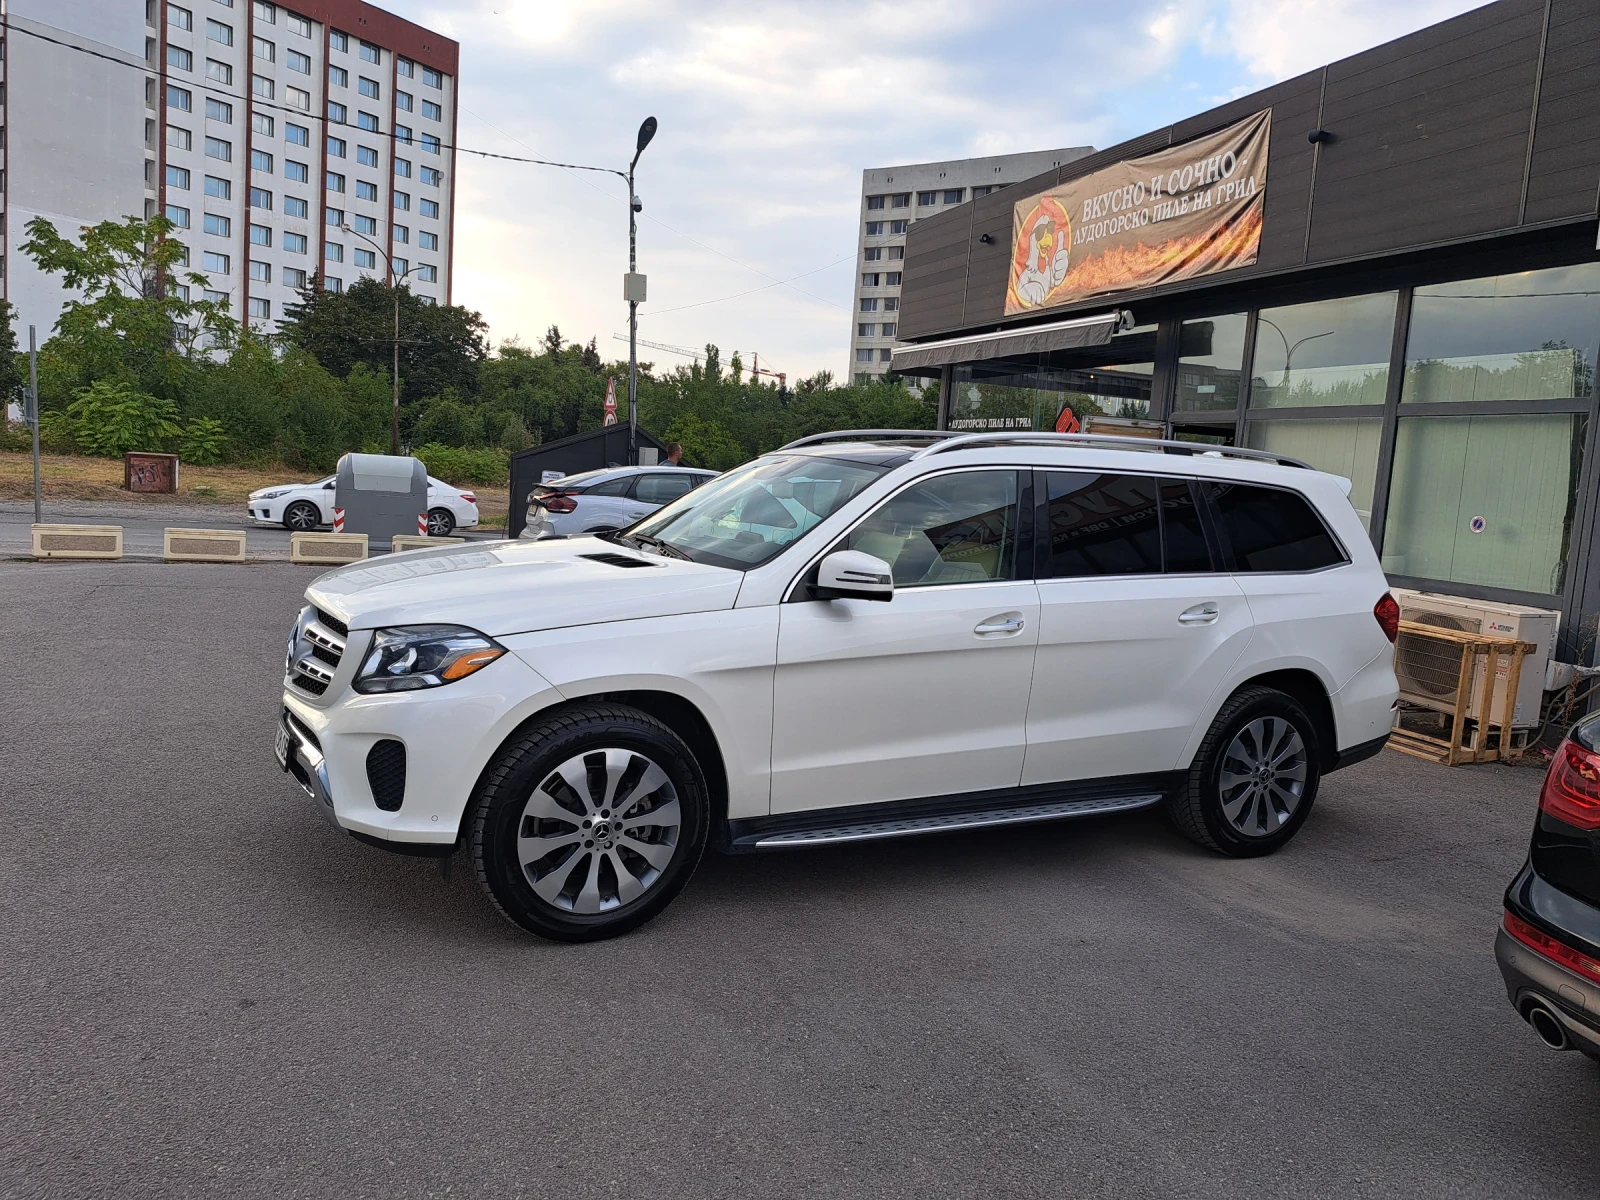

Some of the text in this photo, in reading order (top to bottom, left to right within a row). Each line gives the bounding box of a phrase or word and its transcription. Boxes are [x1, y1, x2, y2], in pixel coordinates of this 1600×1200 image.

[1073, 176, 1257, 246] ЛУДОГОРСКО ПИЛЕ НА ГРИЛ
[1082, 181, 1145, 222] ВКУСНО
[1150, 175, 1164, 202] И
[1168, 151, 1236, 196] СОЧНО
[951, 417, 1031, 430] ЛУДОГОРСКО ПИЛЕ НА ГРИЛ
